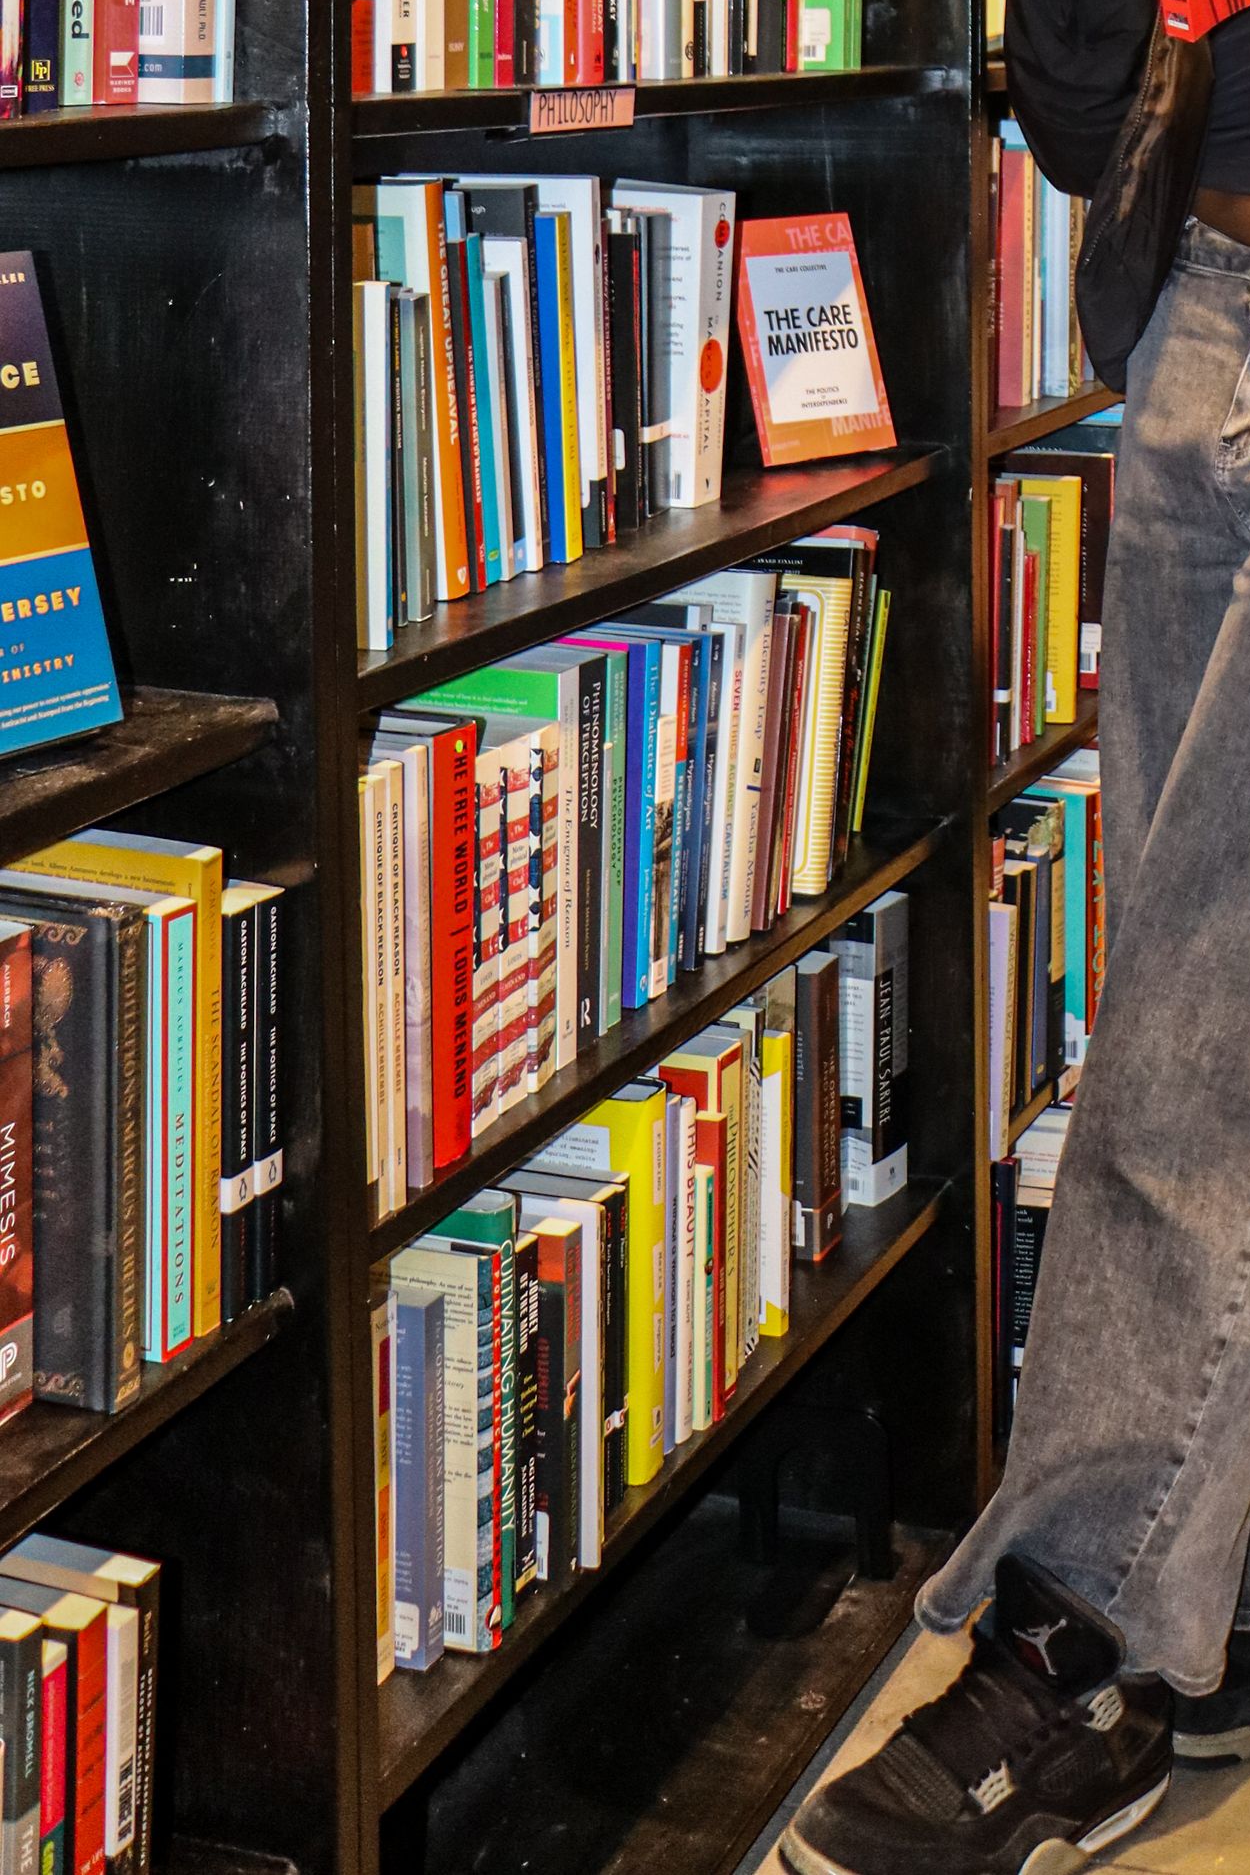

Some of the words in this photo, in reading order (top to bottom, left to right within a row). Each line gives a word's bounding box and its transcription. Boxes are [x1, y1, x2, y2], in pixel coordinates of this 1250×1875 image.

[538, 91, 617, 127] PHILOSOPHY
[437, 222, 448, 261] THE
[438, 265, 454, 333] GREAT
[764, 307, 801, 332] THE
[806, 304, 853, 327] CARE
[768, 328, 859, 357] MANIFESTO
[443, 337, 459, 445] UPHEAVAL
[581, 695, 592, 718] OF
[580, 721, 592, 824] PERCEPTION
[589, 681, 602, 829] PHENOMENOLOGY
[453, 787, 468, 836] FREE
[563, 788, 573, 816] The
[561, 821, 573, 876] Enigma
[453, 843, 468, 915] WORLD
[563, 879, 574, 895] of
[269, 906, 277, 950] GASTON
[563, 897, 573, 950] Reason
[176, 941, 185, 1005] MARCUS
[268, 952, 278, 1015] BACHELARD
[453, 946, 469, 1007] LOUIS
[269, 1026, 277, 1046] THE
[878, 980, 892, 1068] JEAN-PAUL
[175, 1014, 185, 1094] AURELIUS
[269, 1048, 277, 1091] POETICS
[451, 1011, 468, 1100] MENAND
[269, 1094, 277, 1108] OF
[269, 1110, 277, 1144] SPACE
[878, 1073, 892, 1127] SARTRE
[0, 1121, 16, 1266] MIMESIS
[173, 1113, 187, 1306] MEDITATIONS
[500, 1239, 515, 1392] CULTIVATING
[500, 1403, 515, 1533] HUMANITY
[24, 1669, 35, 1708] NICK
[24, 1714, 34, 1779] BROMELL
